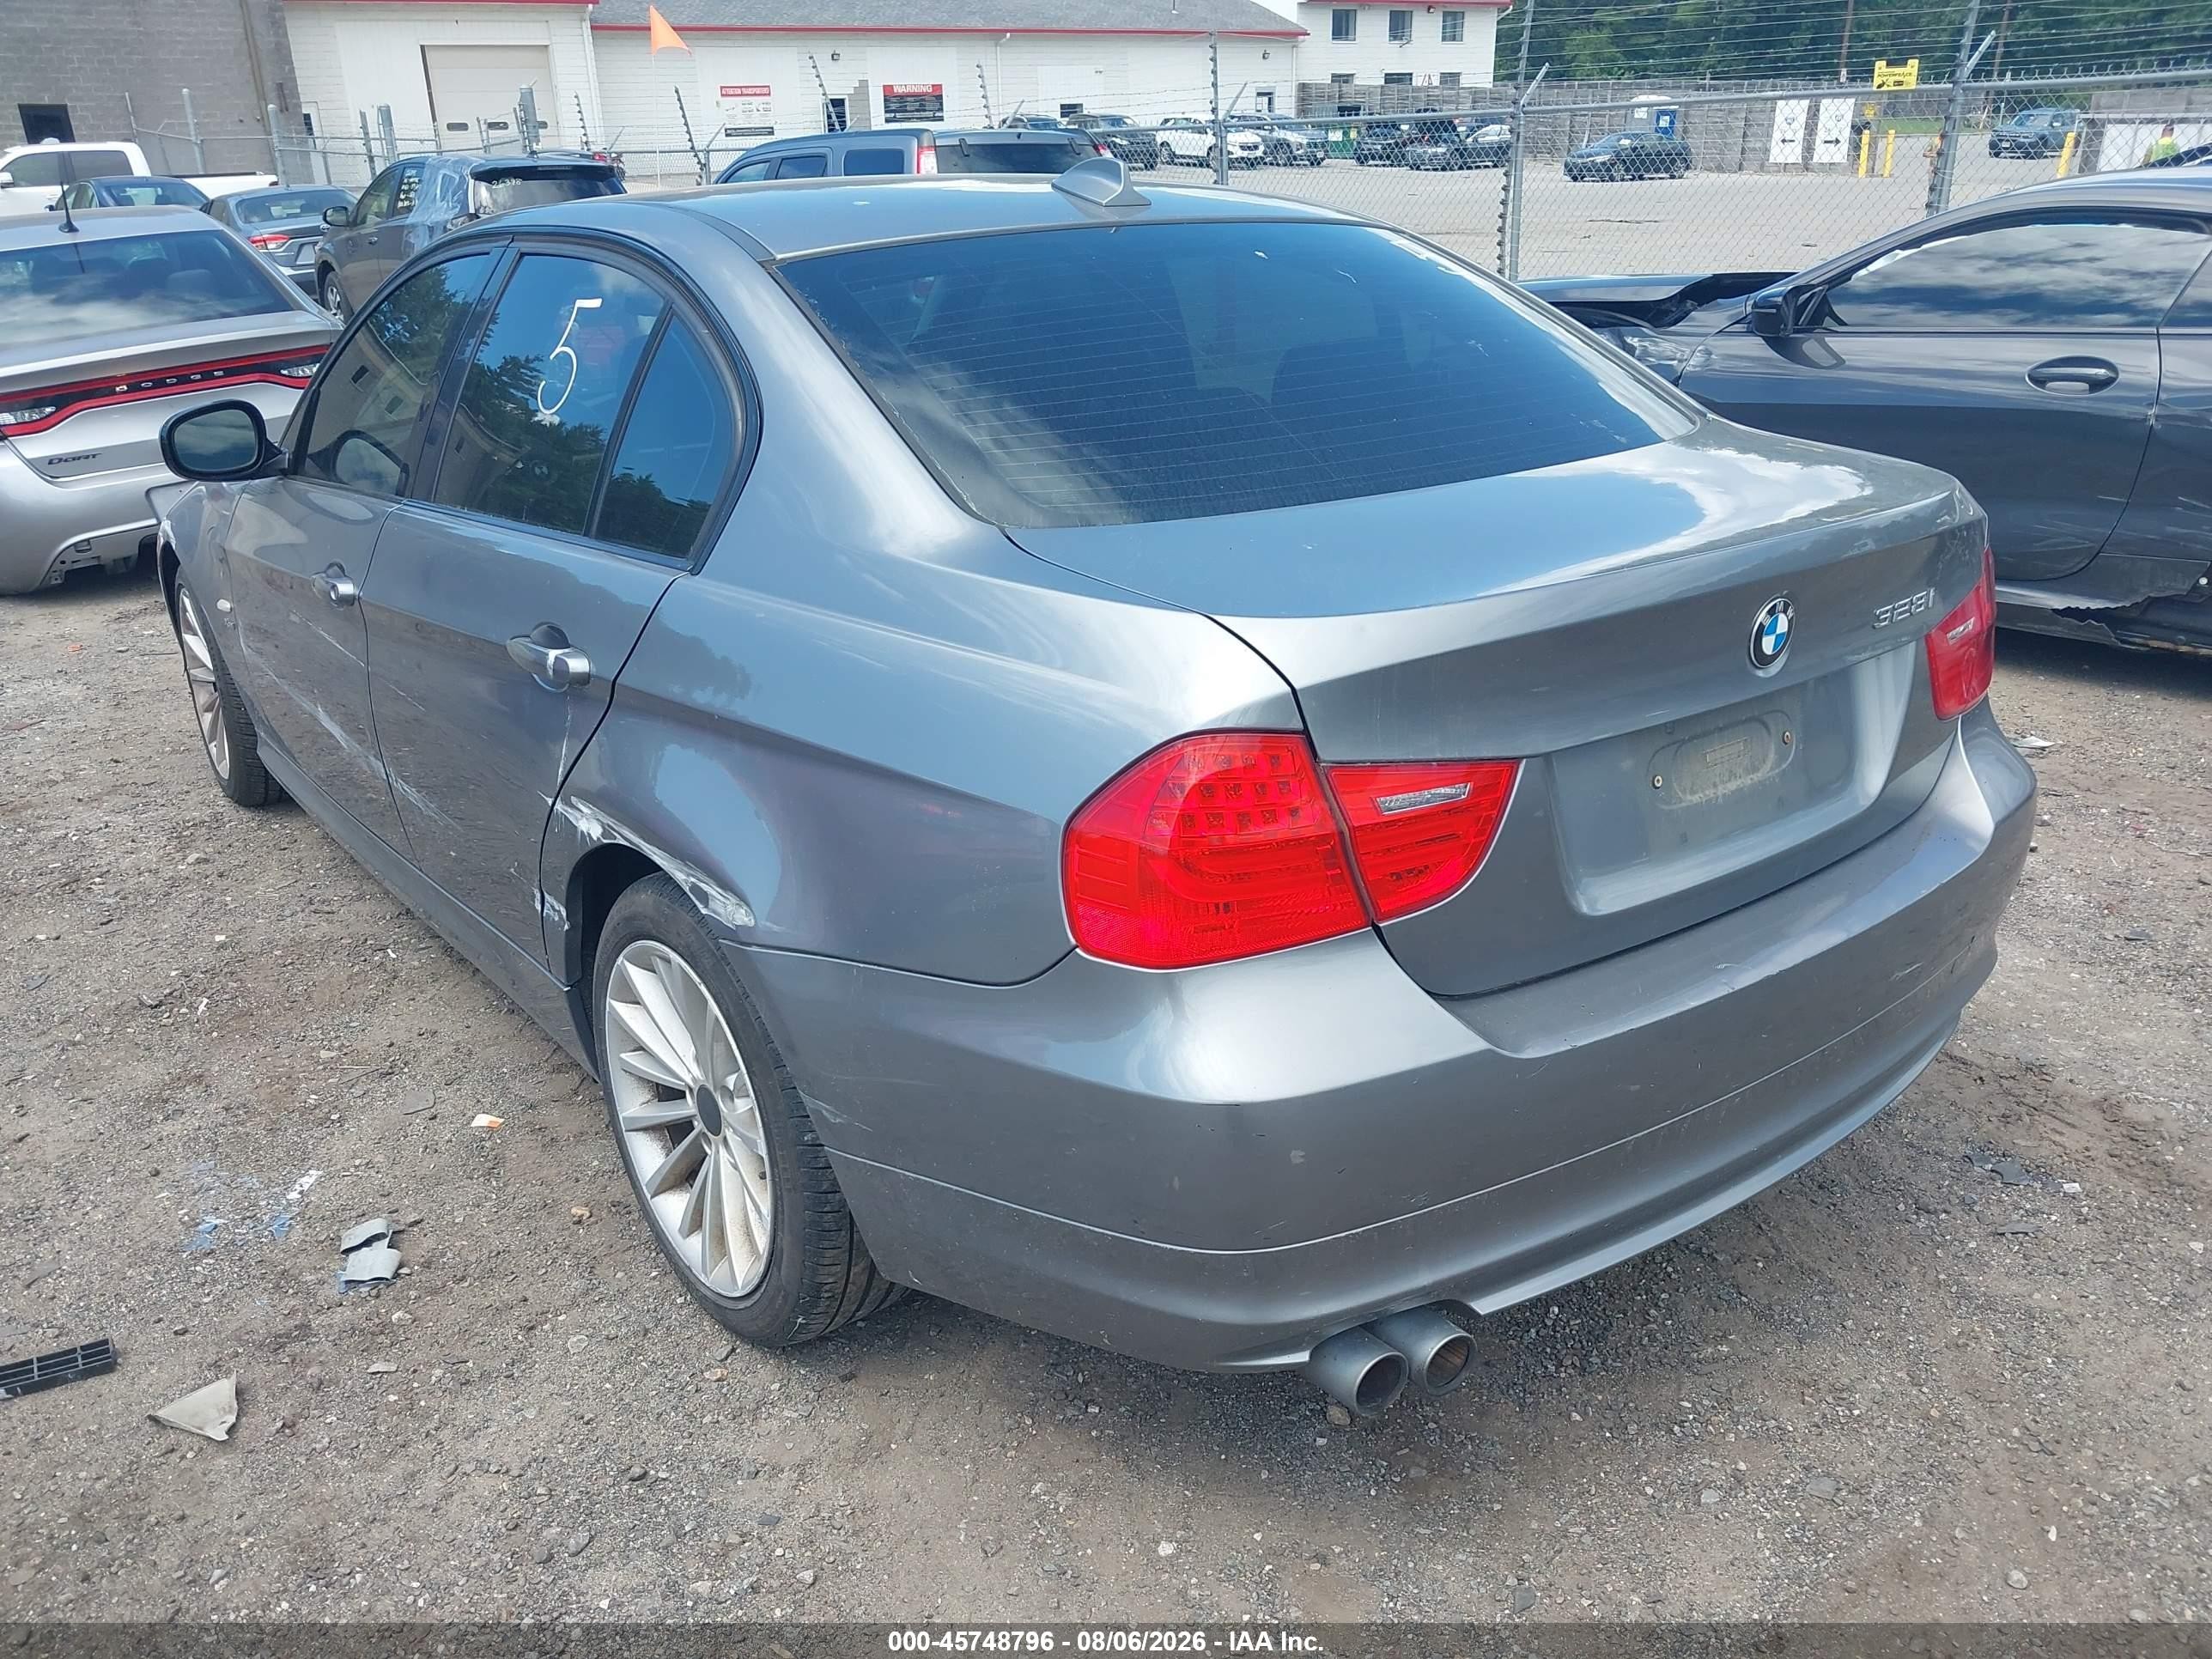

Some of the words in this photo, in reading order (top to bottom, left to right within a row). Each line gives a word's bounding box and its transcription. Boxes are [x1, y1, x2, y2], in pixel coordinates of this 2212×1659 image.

[893, 84, 933, 93] WARNING
[537, 297, 604, 415] 5
[115, 370, 225, 392] DODGE
[1759, 600, 1795, 626] BMW
[1872, 586, 1936, 629] 328i
